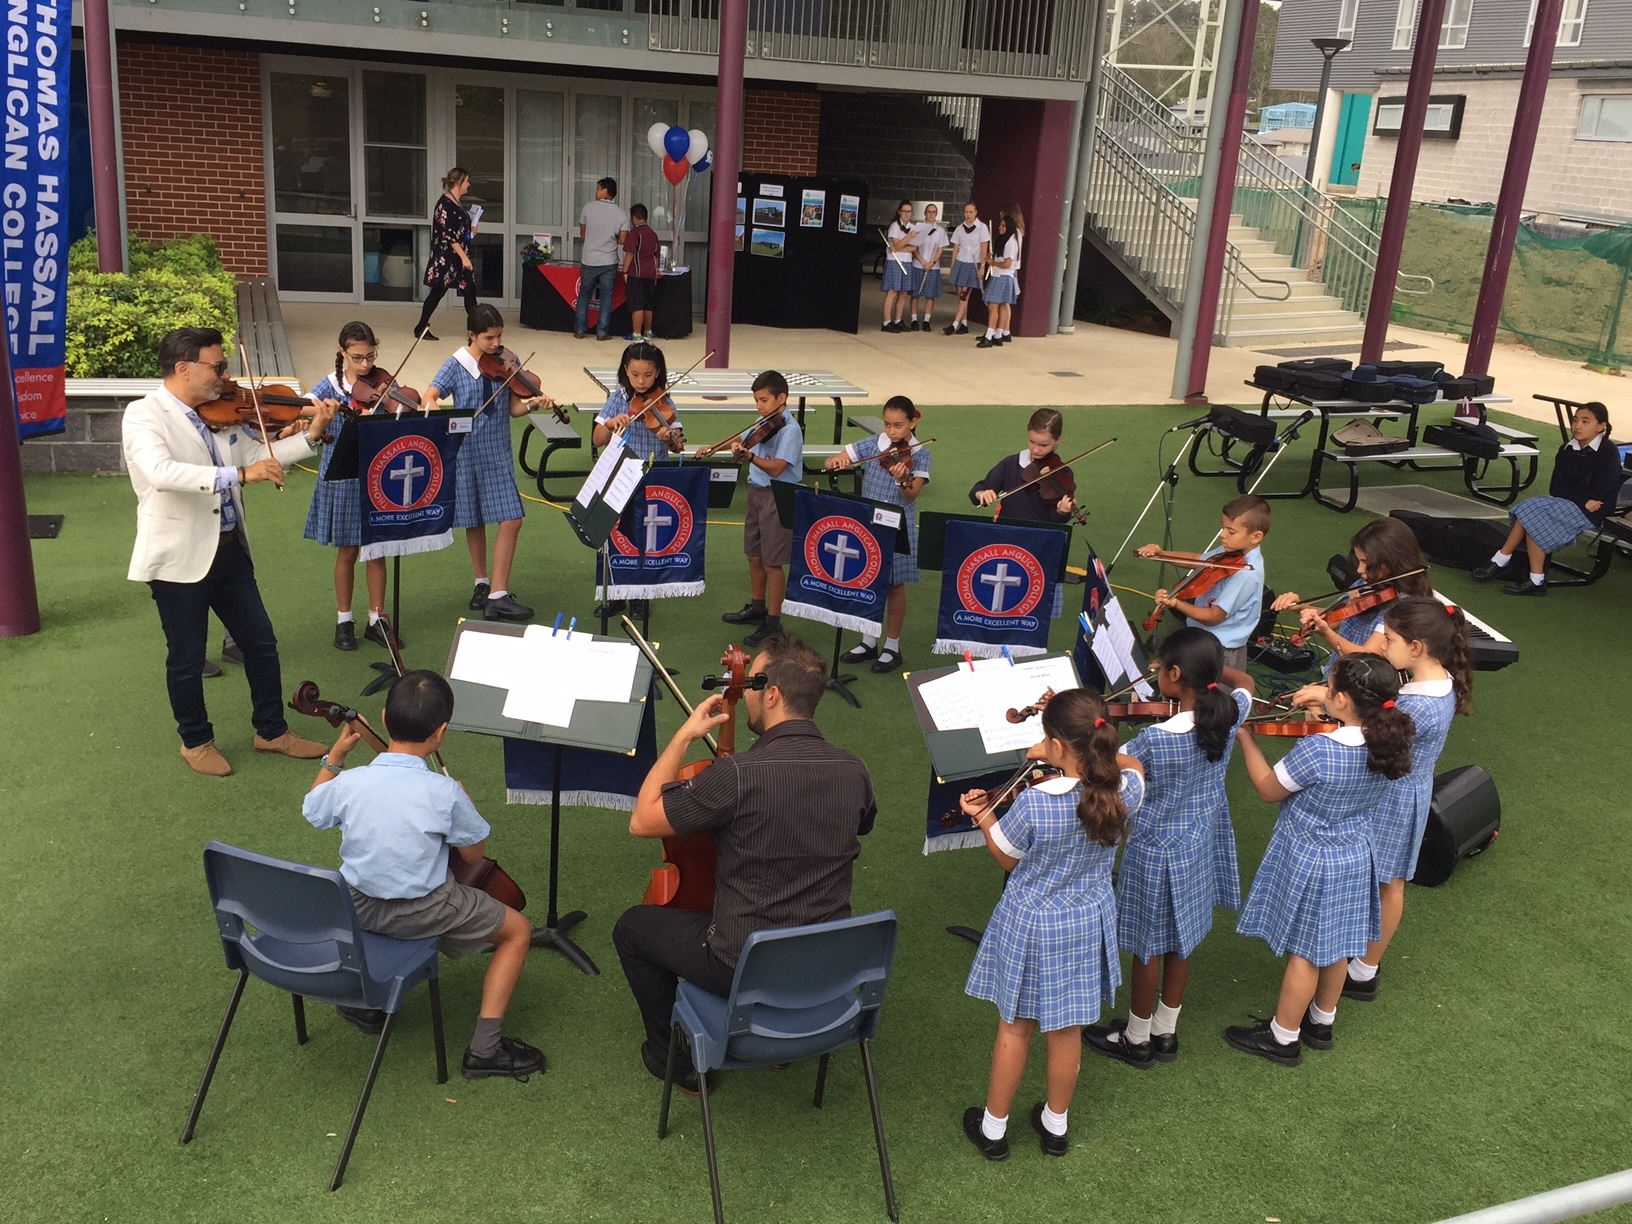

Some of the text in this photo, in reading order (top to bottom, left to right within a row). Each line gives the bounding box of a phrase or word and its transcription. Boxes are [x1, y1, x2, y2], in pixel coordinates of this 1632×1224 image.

[28, 174, 59, 356] HASSALL
[371, 439, 441, 510] THOMAS HASSALL ANGLICAN COLLEGE
[375, 514, 395, 522] MORE
[425, 508, 441, 516] WAY
[615, 525, 632, 554] THOM
[651, 489, 688, 515] ANGLICAN
[671, 515, 690, 552] COLLEGE
[619, 558, 639, 566] MORE
[645, 557, 673, 566] CELLENT
[674, 556, 689, 564] WAY
[809, 520, 878, 587] THOMAS HASSALL ANGLICAN COLLEGE
[962, 548, 1042, 615] THOMAS HASSALL ANGLICAN COLLEGE
[810, 580, 828, 590] MORE
[828, 585, 860, 597] EXCELLENT
[860, 592, 874, 600] WAY
[963, 615, 983, 623] MORE
[984, 618, 1020, 627] EXCELLENT
